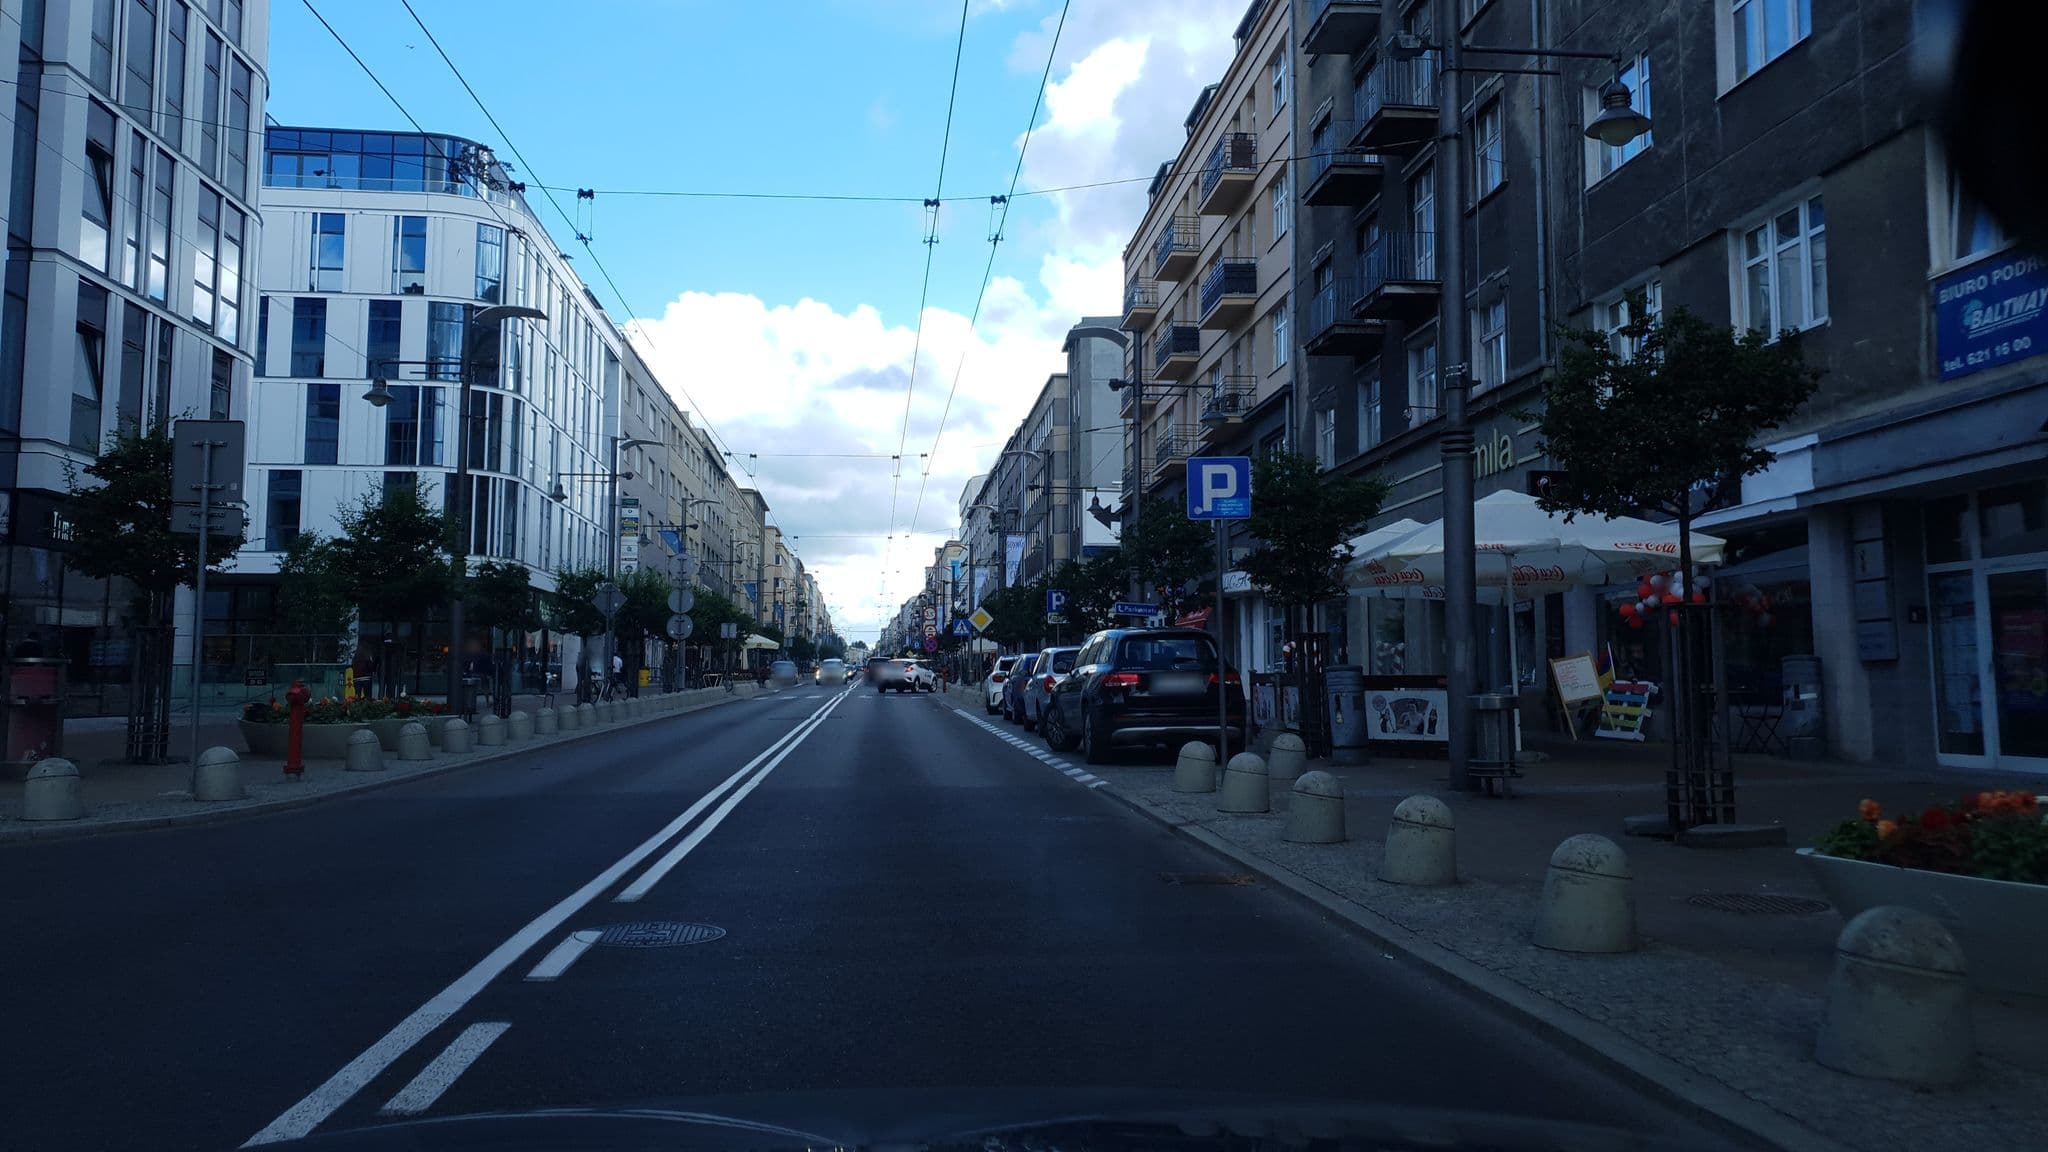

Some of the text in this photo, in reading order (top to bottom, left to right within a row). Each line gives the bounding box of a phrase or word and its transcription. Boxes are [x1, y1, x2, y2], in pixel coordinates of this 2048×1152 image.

[1939, 256, 2042, 304] BIURO PODR
[1969, 287, 2048, 329] BALTWAY
[1202, 464, 1237, 512] P
[1052, 592, 1065, 610] P
